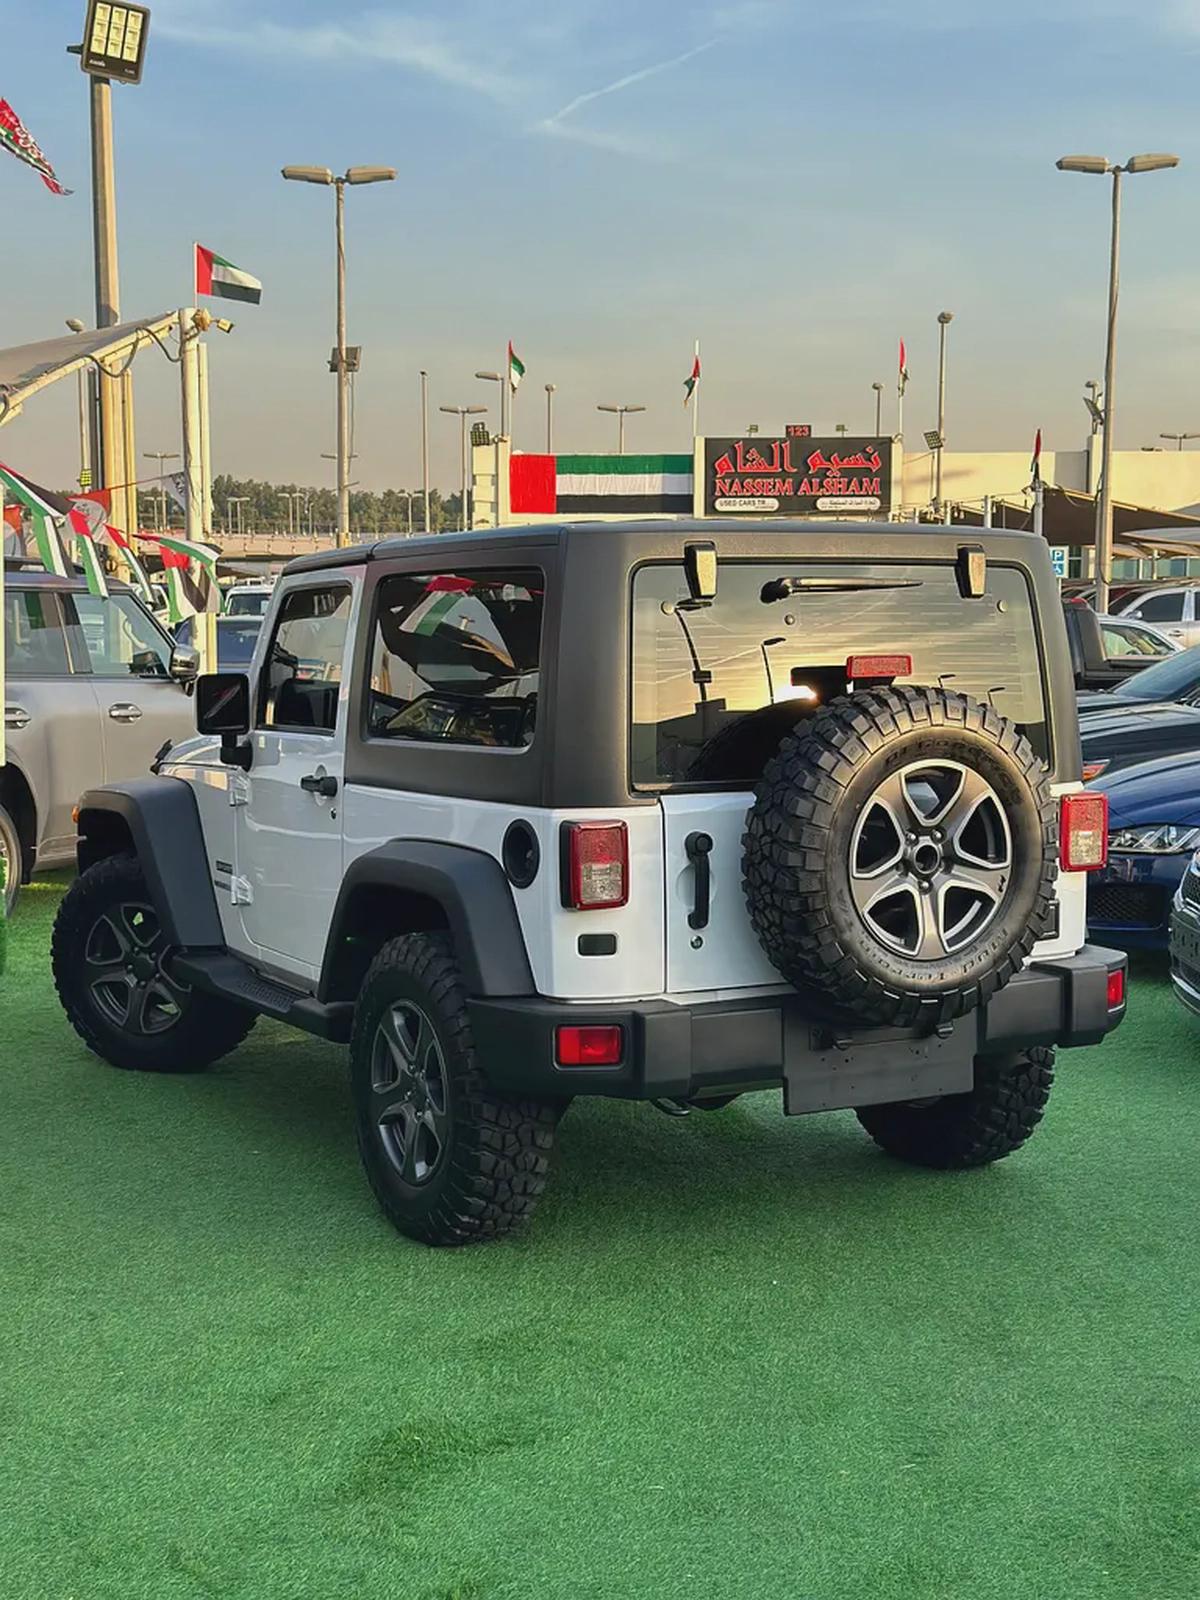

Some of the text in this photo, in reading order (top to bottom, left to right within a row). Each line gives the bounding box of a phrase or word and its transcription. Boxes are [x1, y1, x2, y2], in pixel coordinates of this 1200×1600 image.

[788, 426, 809, 436] 123
[714, 441, 882, 477] نسيم الشام
[714, 477, 882, 496] NASSEM ALSHAM
